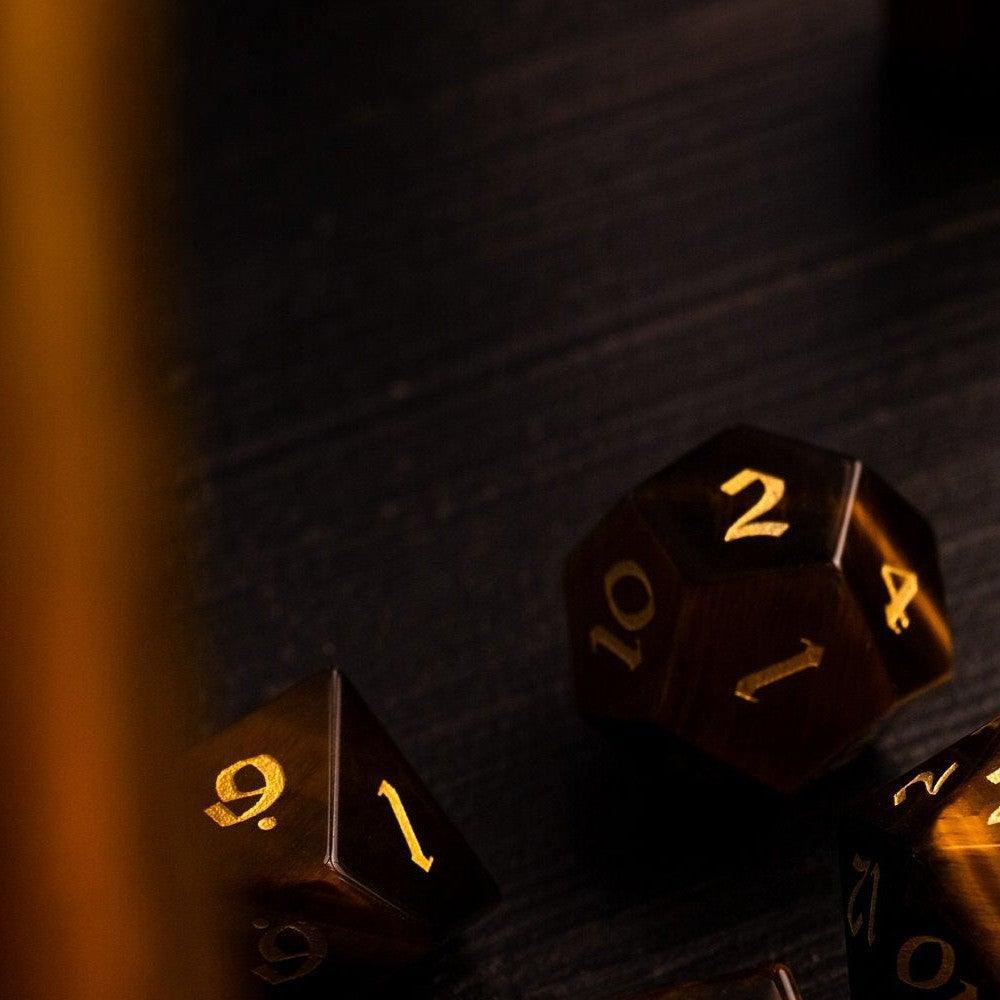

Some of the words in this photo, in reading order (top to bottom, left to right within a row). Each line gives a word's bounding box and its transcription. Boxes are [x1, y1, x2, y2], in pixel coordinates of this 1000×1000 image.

[720, 467, 791, 543] 2
[589, 560, 656, 673] 10
[880, 564, 919, 636] 4
[734, 637, 825, 703] 1
[377, 778, 435, 874] 1
